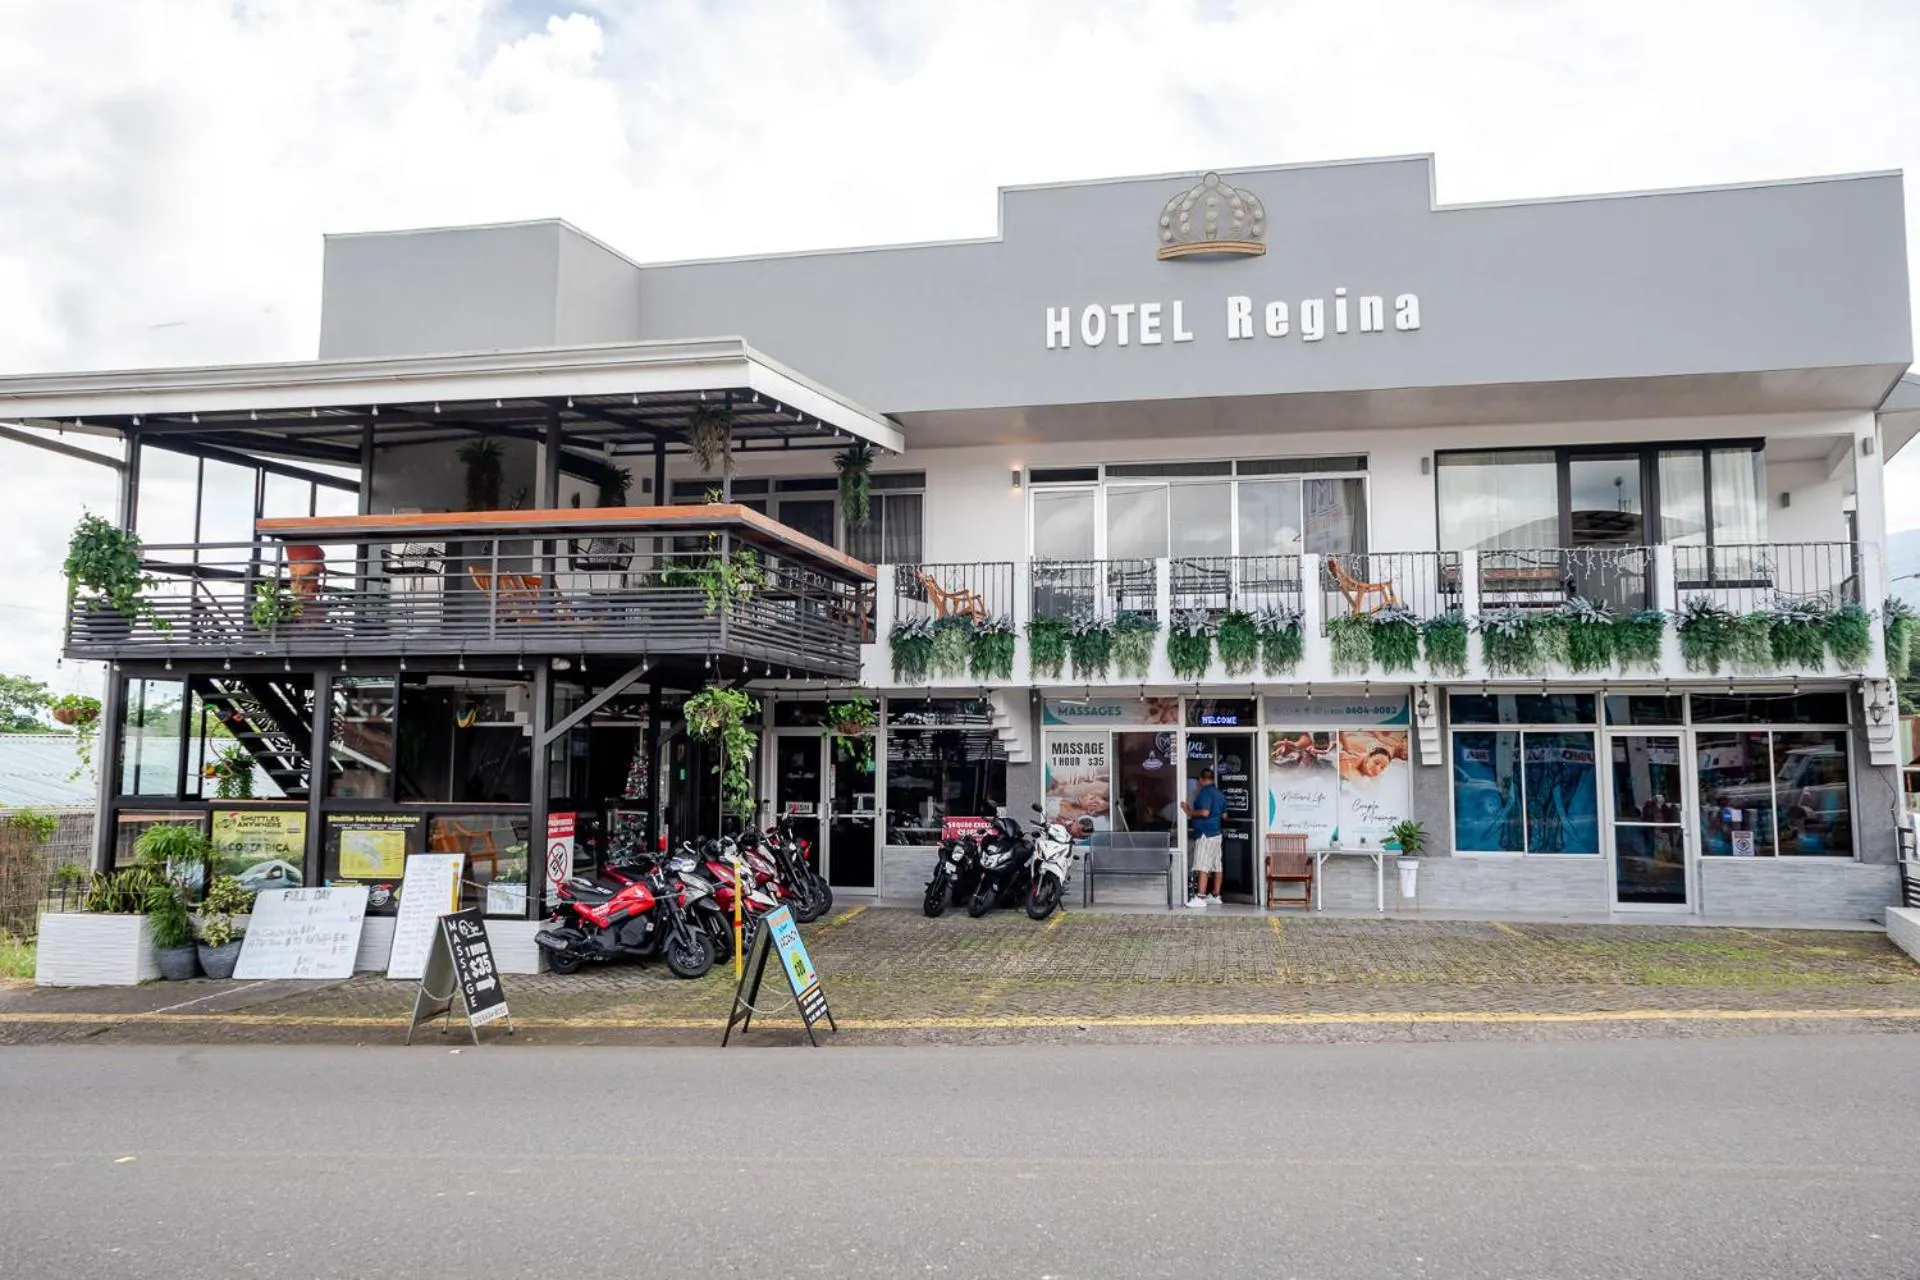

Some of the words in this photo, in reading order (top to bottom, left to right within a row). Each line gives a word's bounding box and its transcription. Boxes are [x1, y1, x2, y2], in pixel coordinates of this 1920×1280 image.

[1046, 301, 1195, 348] HOTEL
[1227, 287, 1421, 342] Regina
[1057, 706, 1122, 716] MASSAGES
[1202, 716, 1237, 724] WELCOME
[1051, 743, 1104, 755] MASSAGE
[1059, 757, 1081, 766] HOUR
[327, 815, 354, 823] Shuttle
[355, 815, 382, 823] Service
[384, 815, 420, 824] Anywhere
[448, 921, 478, 1008] MASSAGE
[470, 955, 493, 979] $35
